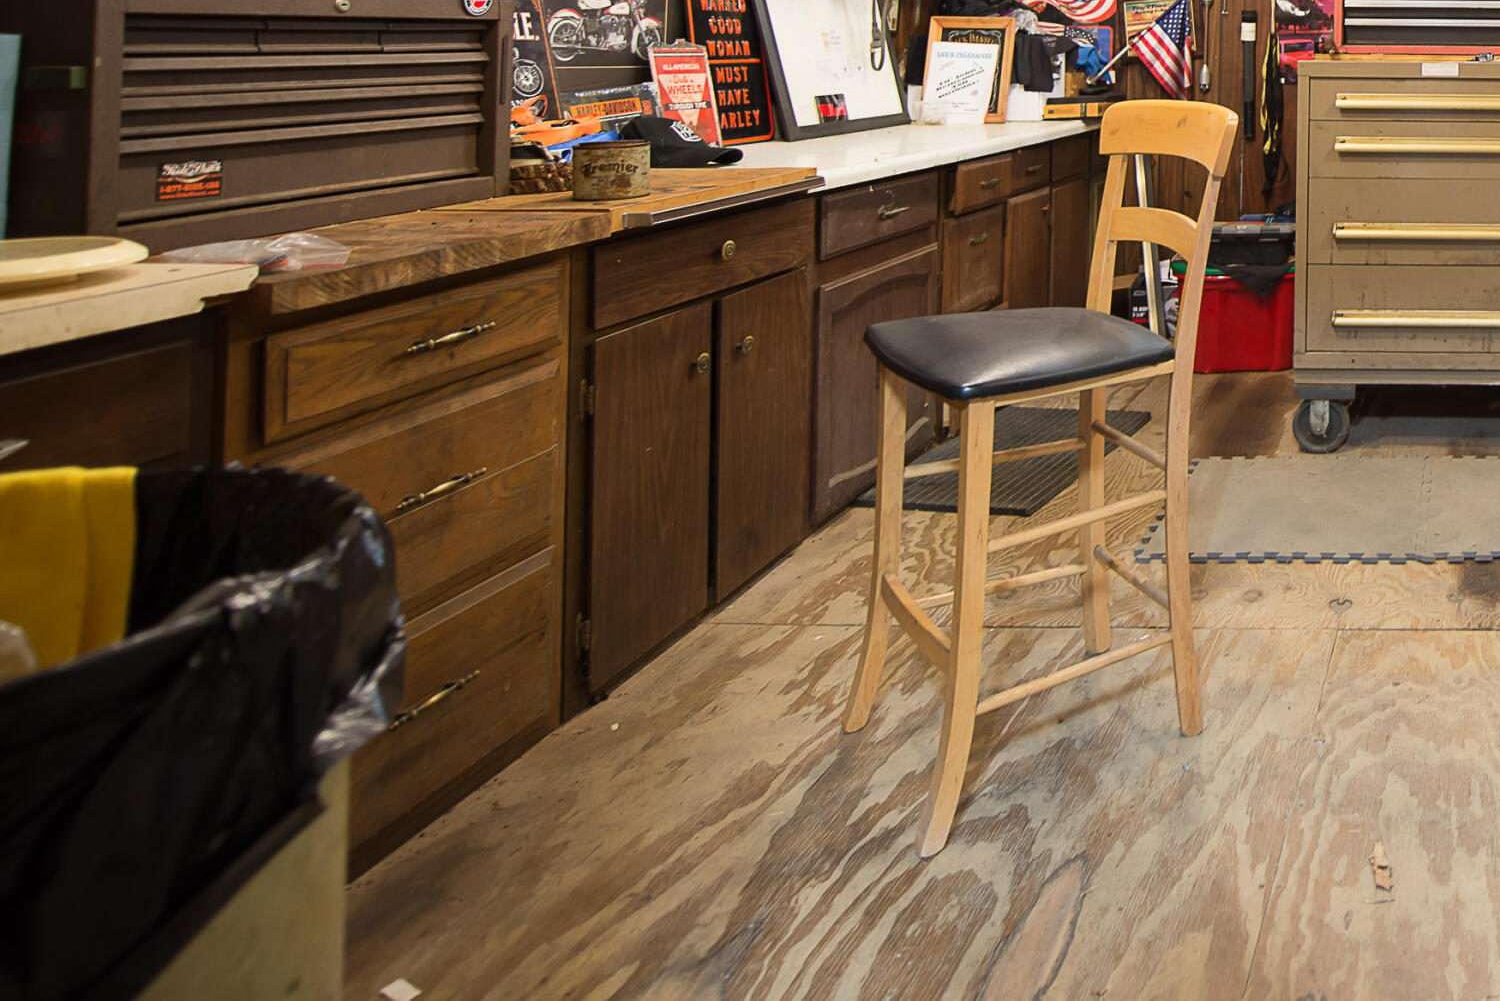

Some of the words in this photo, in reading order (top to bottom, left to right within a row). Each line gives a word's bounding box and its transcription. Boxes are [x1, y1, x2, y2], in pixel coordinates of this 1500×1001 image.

[708, 15, 742, 35] GOOD
[706, 39, 751, 57] WOMAN
[715, 66, 749, 84] MUST
[666, 83, 704, 95] WHEELS
[717, 88, 751, 107] HAVE
[575, 97, 639, 118] HARLEY-DAVIDSON
[720, 109, 761, 130] ARLEY
[582, 157, 640, 179] Premier
